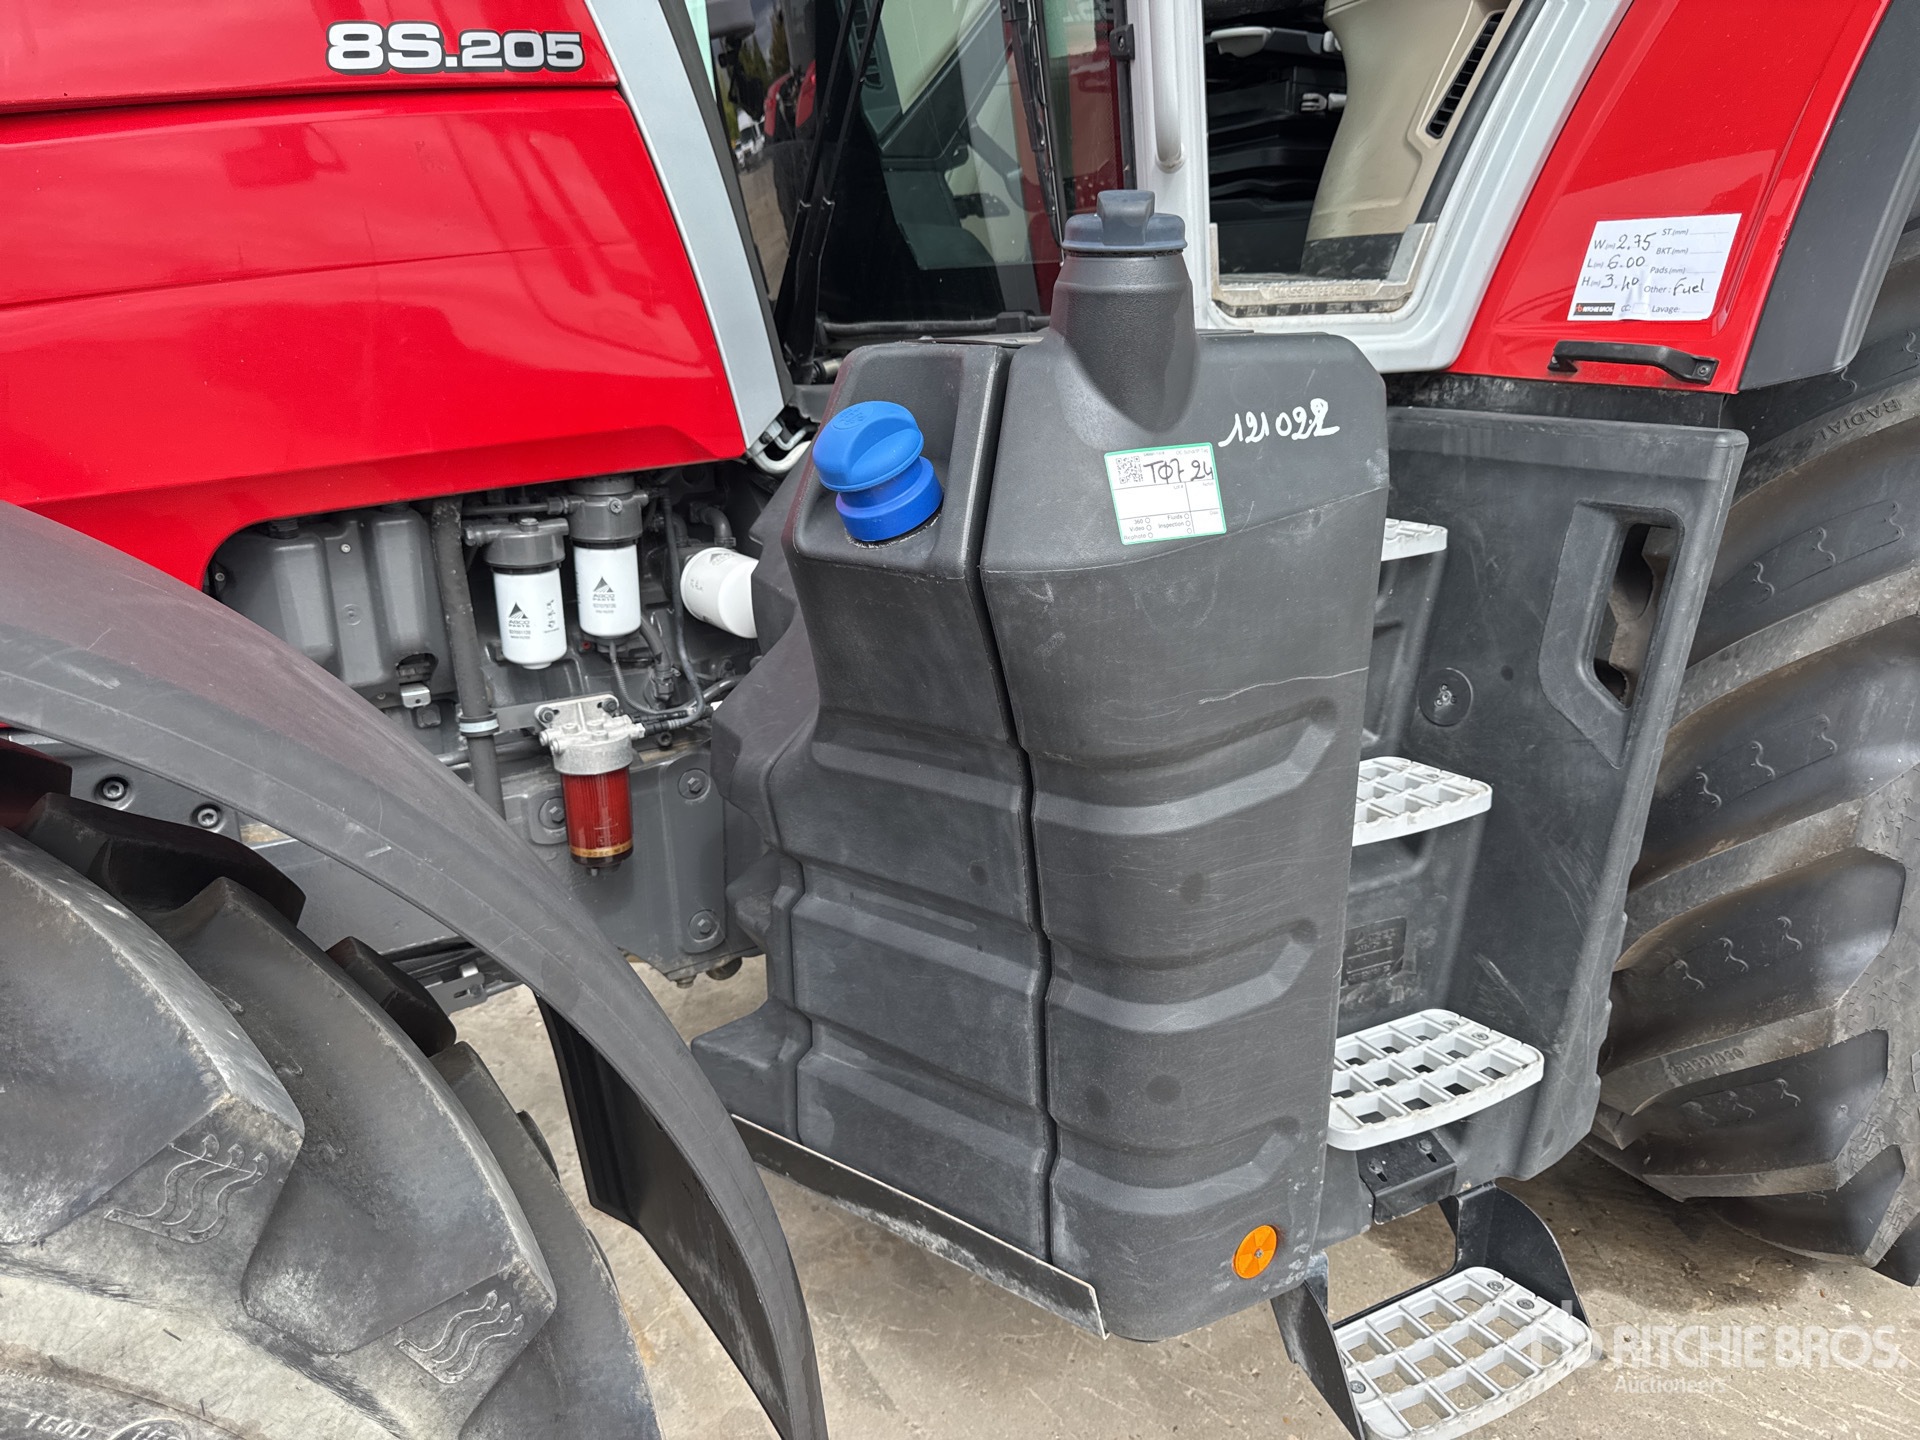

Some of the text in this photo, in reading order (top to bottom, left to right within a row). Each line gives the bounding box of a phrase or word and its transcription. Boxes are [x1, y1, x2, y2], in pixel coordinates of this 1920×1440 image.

[326, 21, 585, 73] 8S.205
[1616, 232, 1657, 251] 2.75
[1607, 254, 1645, 269] 6.00
[1651, 304, 1681, 314] Lavage:
[1815, 399, 1901, 440] RADIAL
[1158, 521, 1185, 529] Inspection
